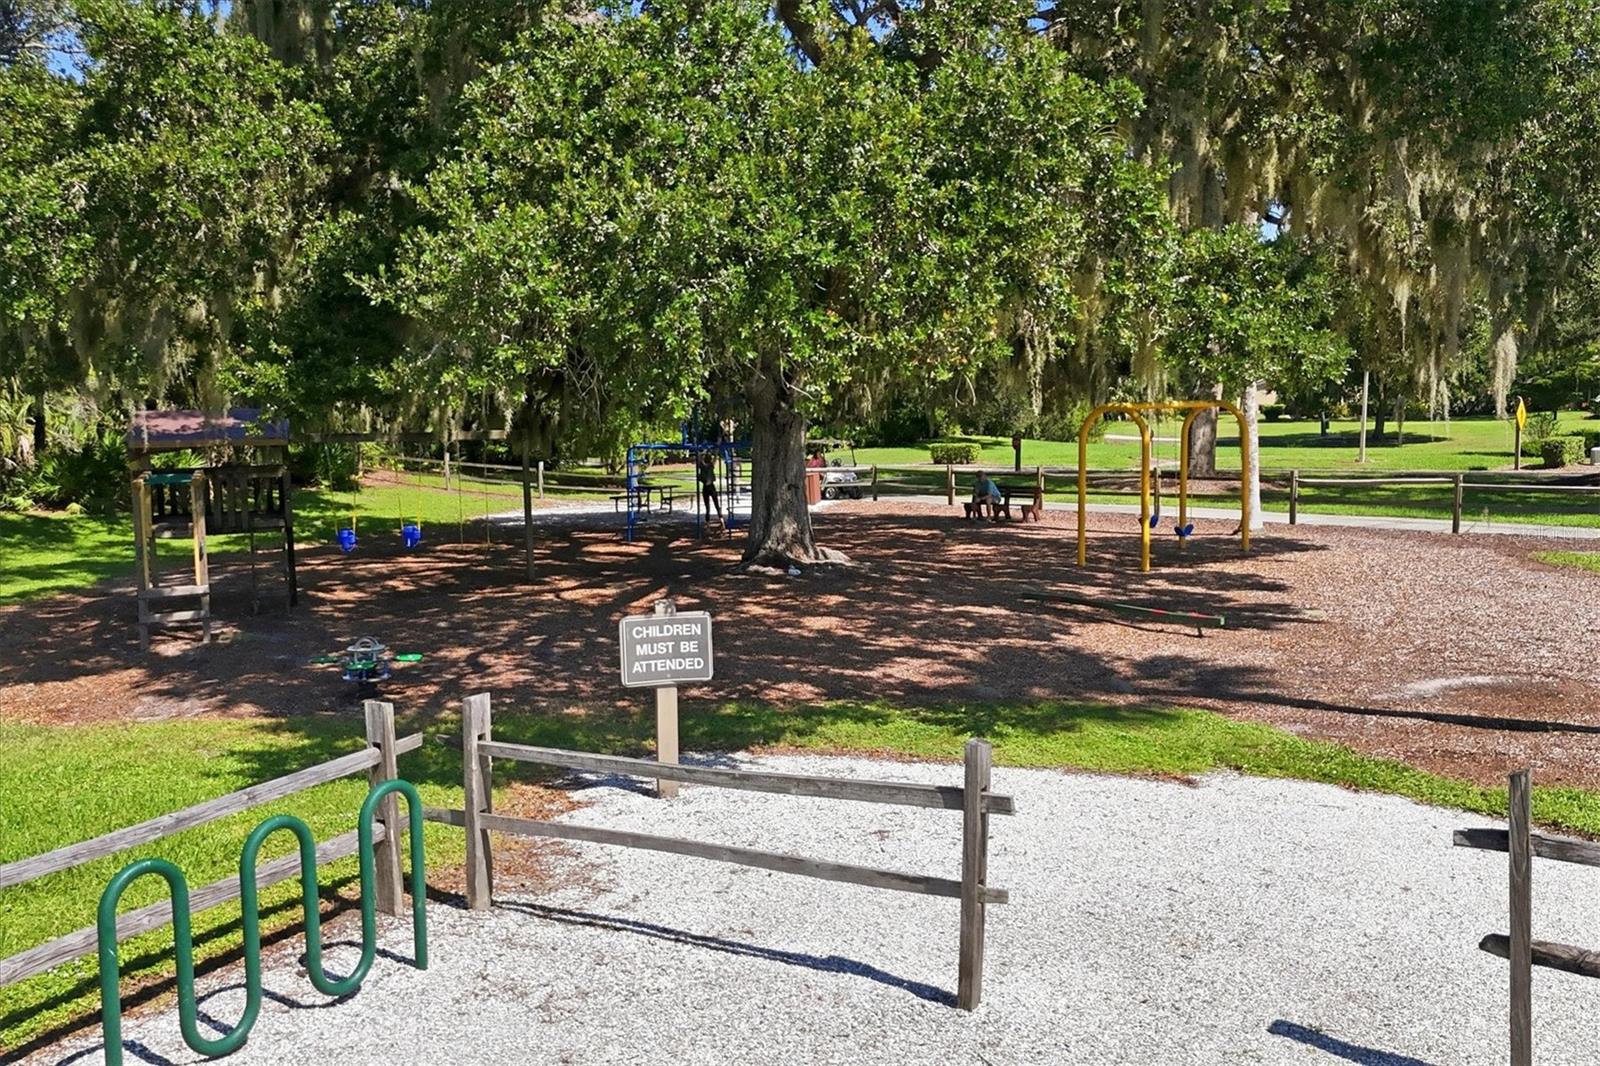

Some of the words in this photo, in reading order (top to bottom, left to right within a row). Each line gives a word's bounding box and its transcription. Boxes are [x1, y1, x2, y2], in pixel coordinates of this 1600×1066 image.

[632, 624, 702, 639] CHILDREN
[636, 642, 675, 656] MUST
[680, 641, 699, 653] BE
[632, 658, 704, 673] ATTENDED
